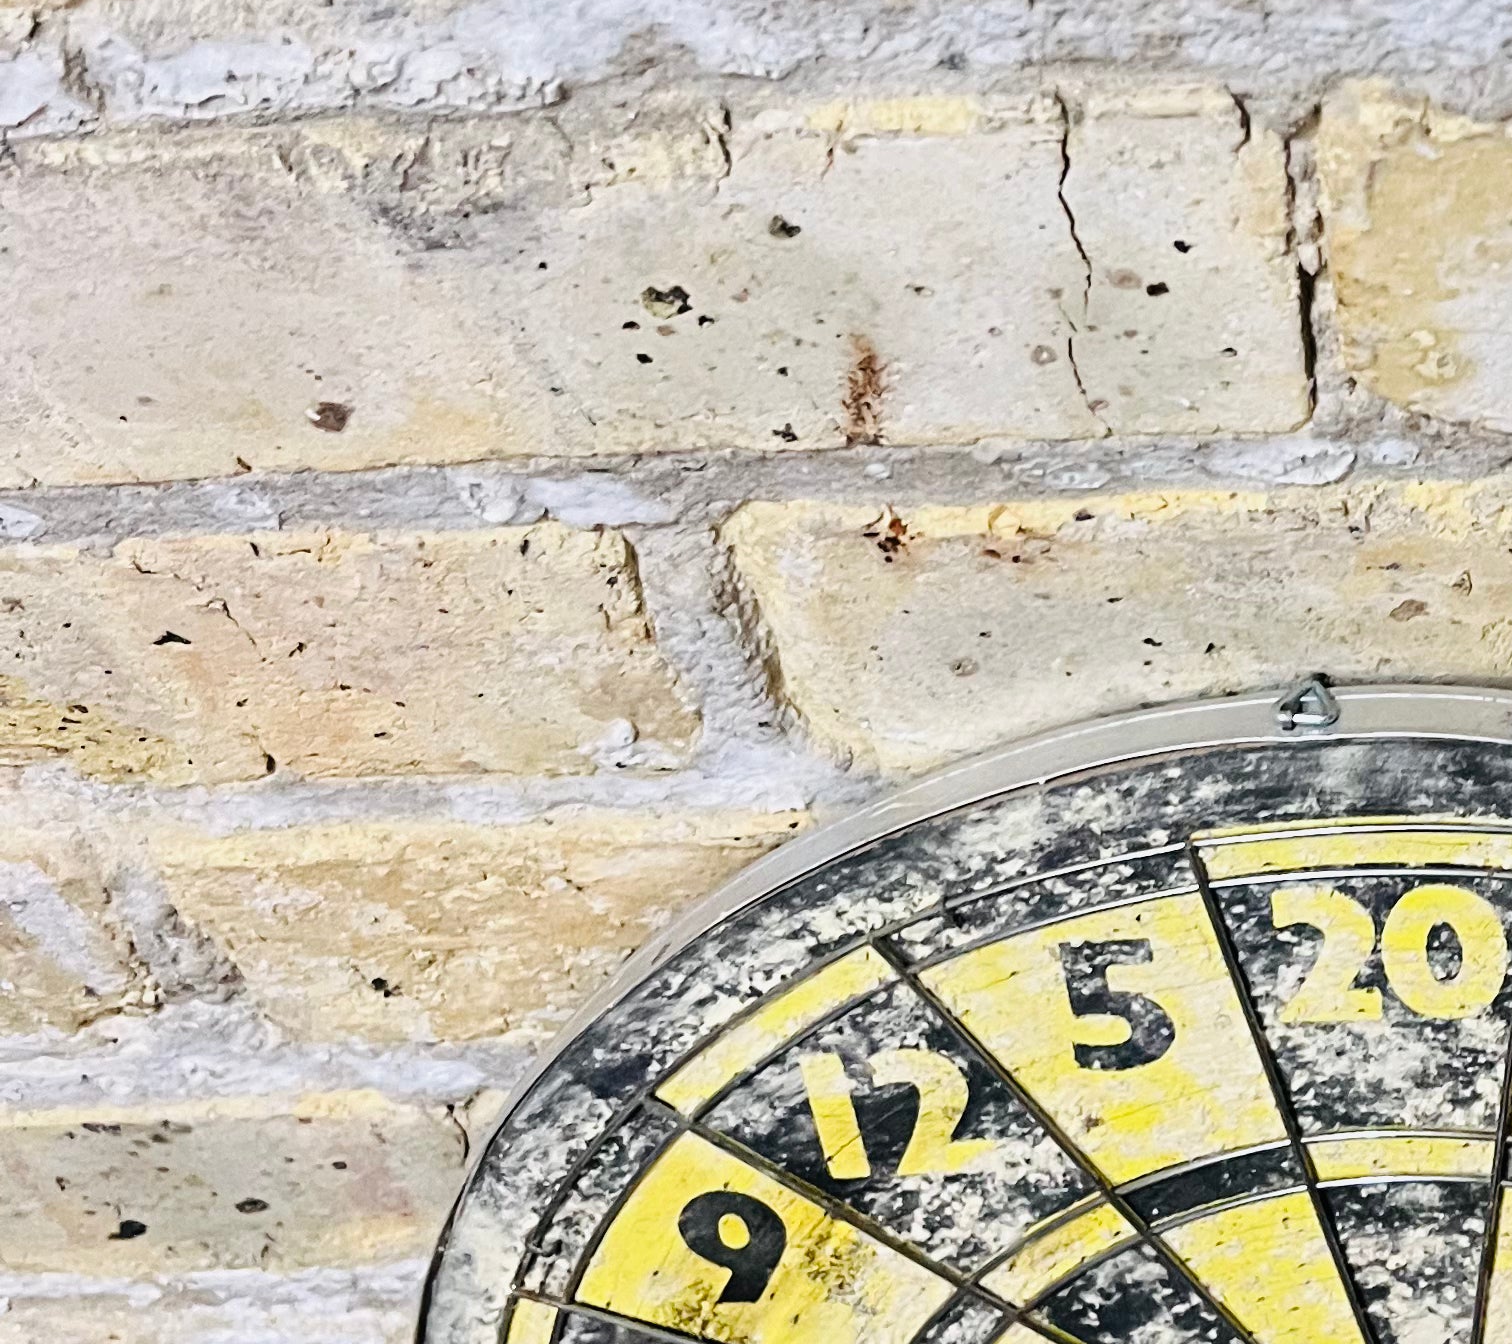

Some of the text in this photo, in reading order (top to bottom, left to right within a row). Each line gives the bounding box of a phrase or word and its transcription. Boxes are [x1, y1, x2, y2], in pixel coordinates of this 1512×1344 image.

[1059, 939, 1176, 1069] 5
[1271, 884, 1508, 1022] 20
[799, 1048, 1005, 1178] 12
[677, 1191, 785, 1303] 9
